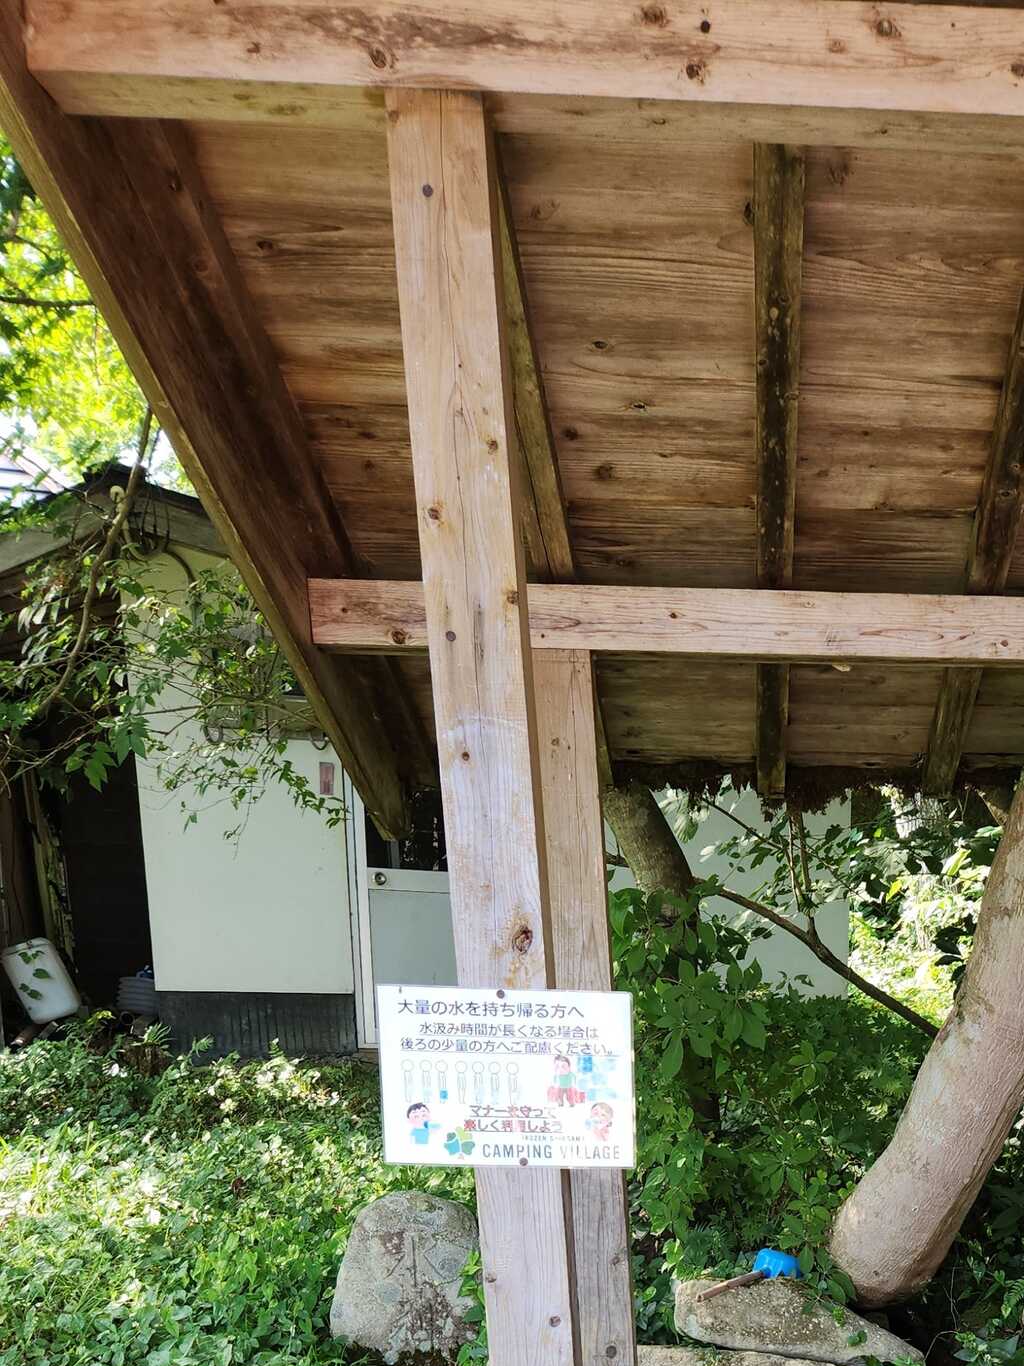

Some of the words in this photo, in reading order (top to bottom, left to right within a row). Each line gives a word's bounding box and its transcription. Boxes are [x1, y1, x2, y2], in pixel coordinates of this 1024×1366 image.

[397, 1000, 585, 1018] 大量の水を持ち帰る方へ
[419, 1022, 600, 1040] 水汲み時間が長くなる場合は
[482, 1143, 553, 1159] CAMPING
[559, 1144, 621, 1160] VILLAGE
